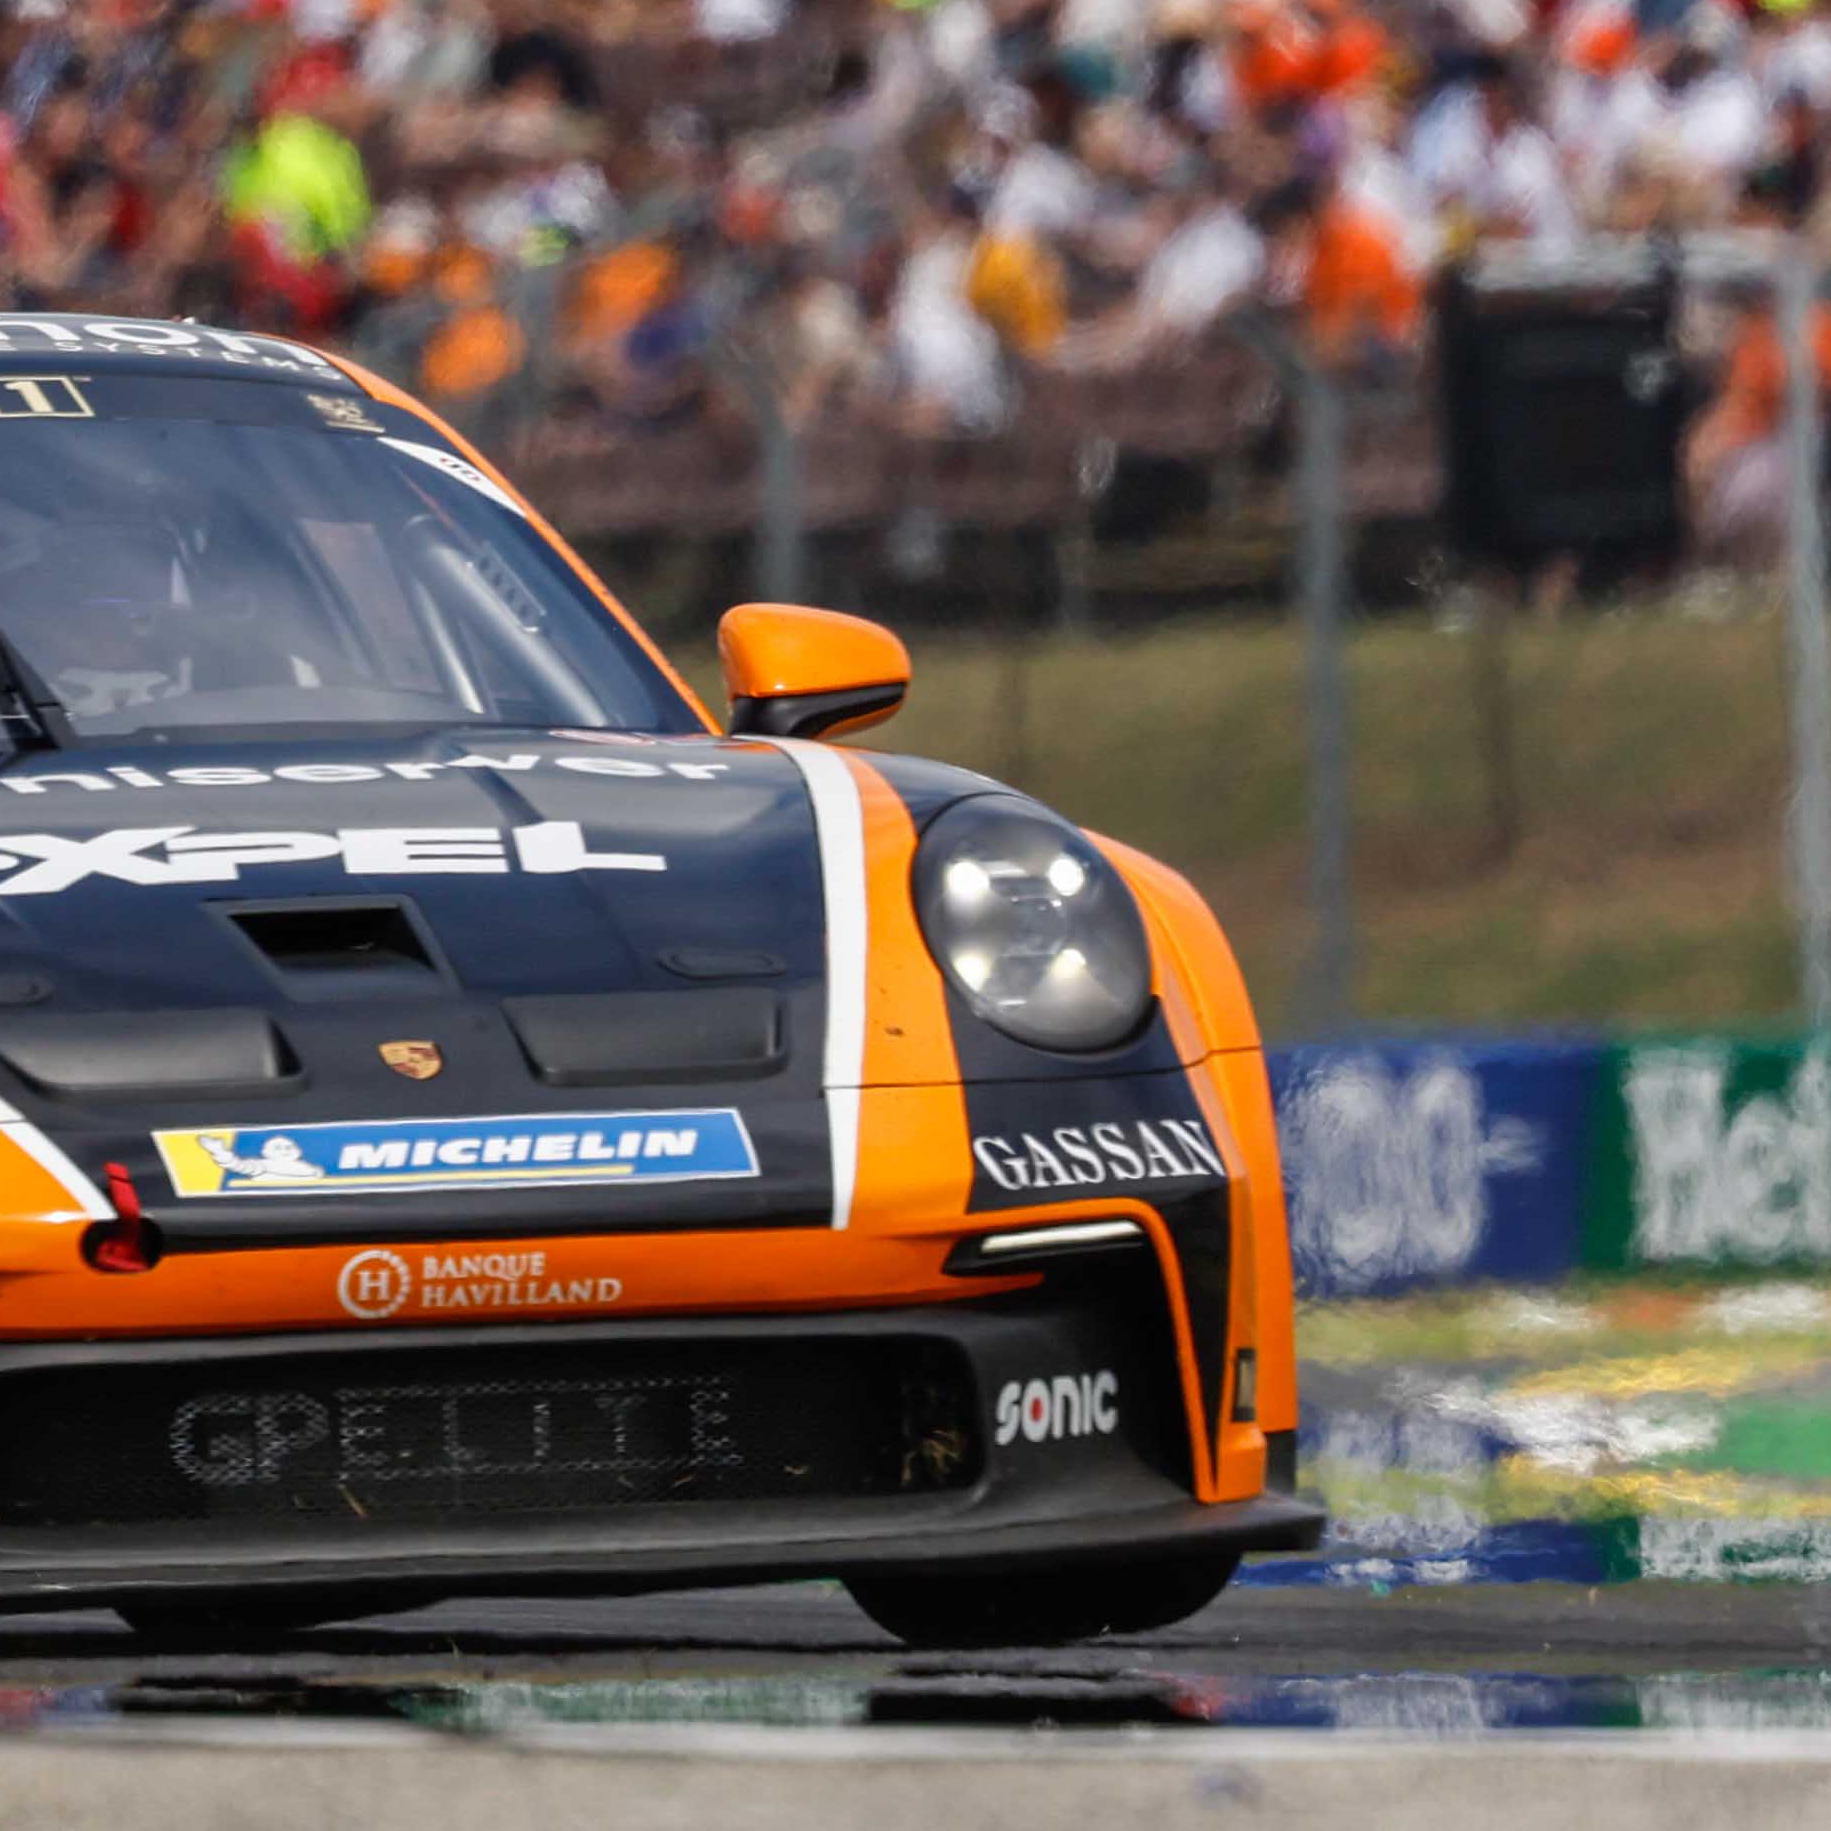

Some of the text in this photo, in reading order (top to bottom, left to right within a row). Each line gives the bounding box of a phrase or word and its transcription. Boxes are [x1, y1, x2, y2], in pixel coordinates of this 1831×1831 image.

[58, 341, 340, 380] SYSTEMS
[337, 1129, 699, 1171] MICHELIN
[972, 1119, 1227, 1191] GASSAN
[422, 1252, 547, 1281] BANQUE
[422, 1277, 623, 1308] HAVILLAND
[169, 1393, 332, 1485] GP
